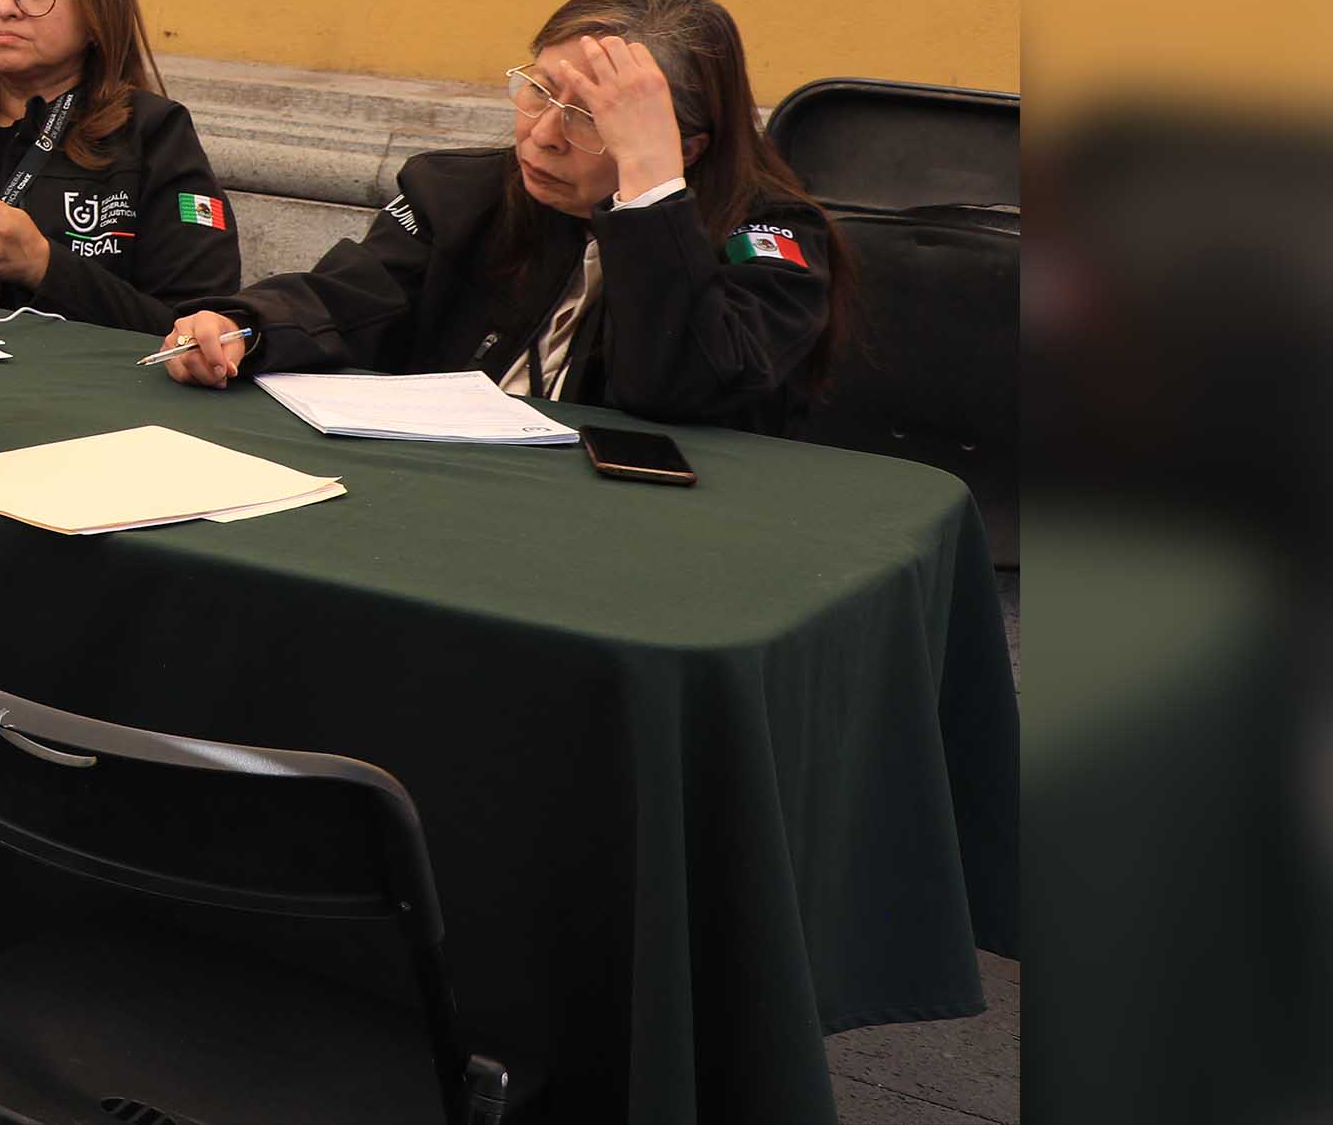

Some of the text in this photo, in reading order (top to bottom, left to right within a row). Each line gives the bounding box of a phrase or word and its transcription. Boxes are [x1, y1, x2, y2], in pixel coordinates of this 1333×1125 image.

[17, 173, 33, 190] CDMX
[108, 208, 137, 218] JUSTICIA
[100, 217, 118, 228] CDMX
[71, 238, 122, 257] FISCAL
